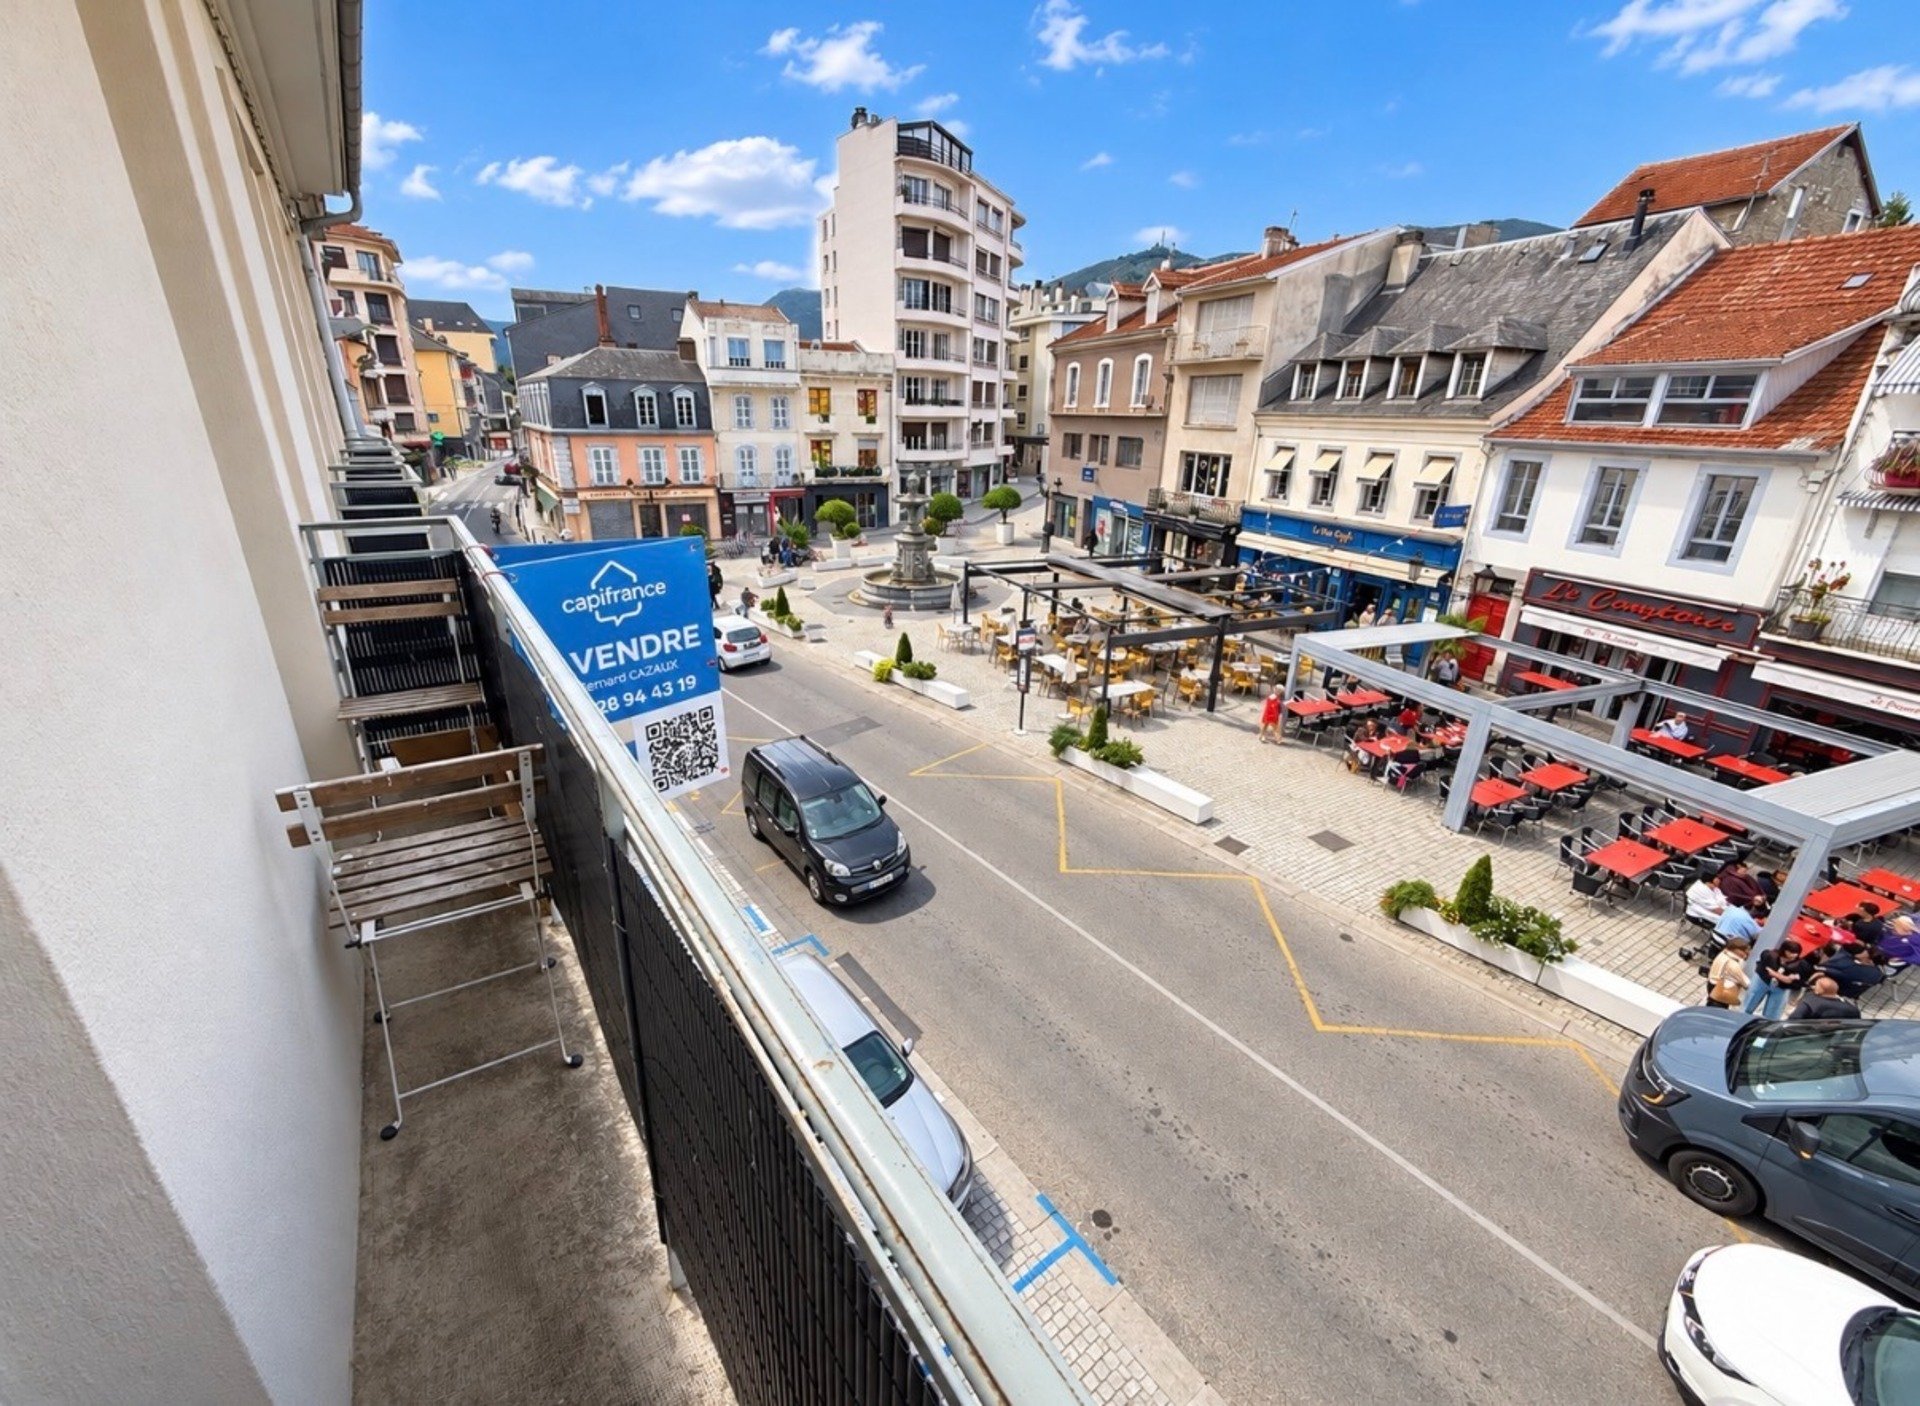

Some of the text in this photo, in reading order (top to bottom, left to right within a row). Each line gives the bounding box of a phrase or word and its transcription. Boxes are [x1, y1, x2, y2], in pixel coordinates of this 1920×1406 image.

[562, 581, 667, 615] capifrance
[1542, 580, 1582, 601] Le
[570, 624, 702, 675] VENDRE
[582, 659, 679, 692] ernard CAZAUX
[596, 674, 697, 714] 28 94 43 19
